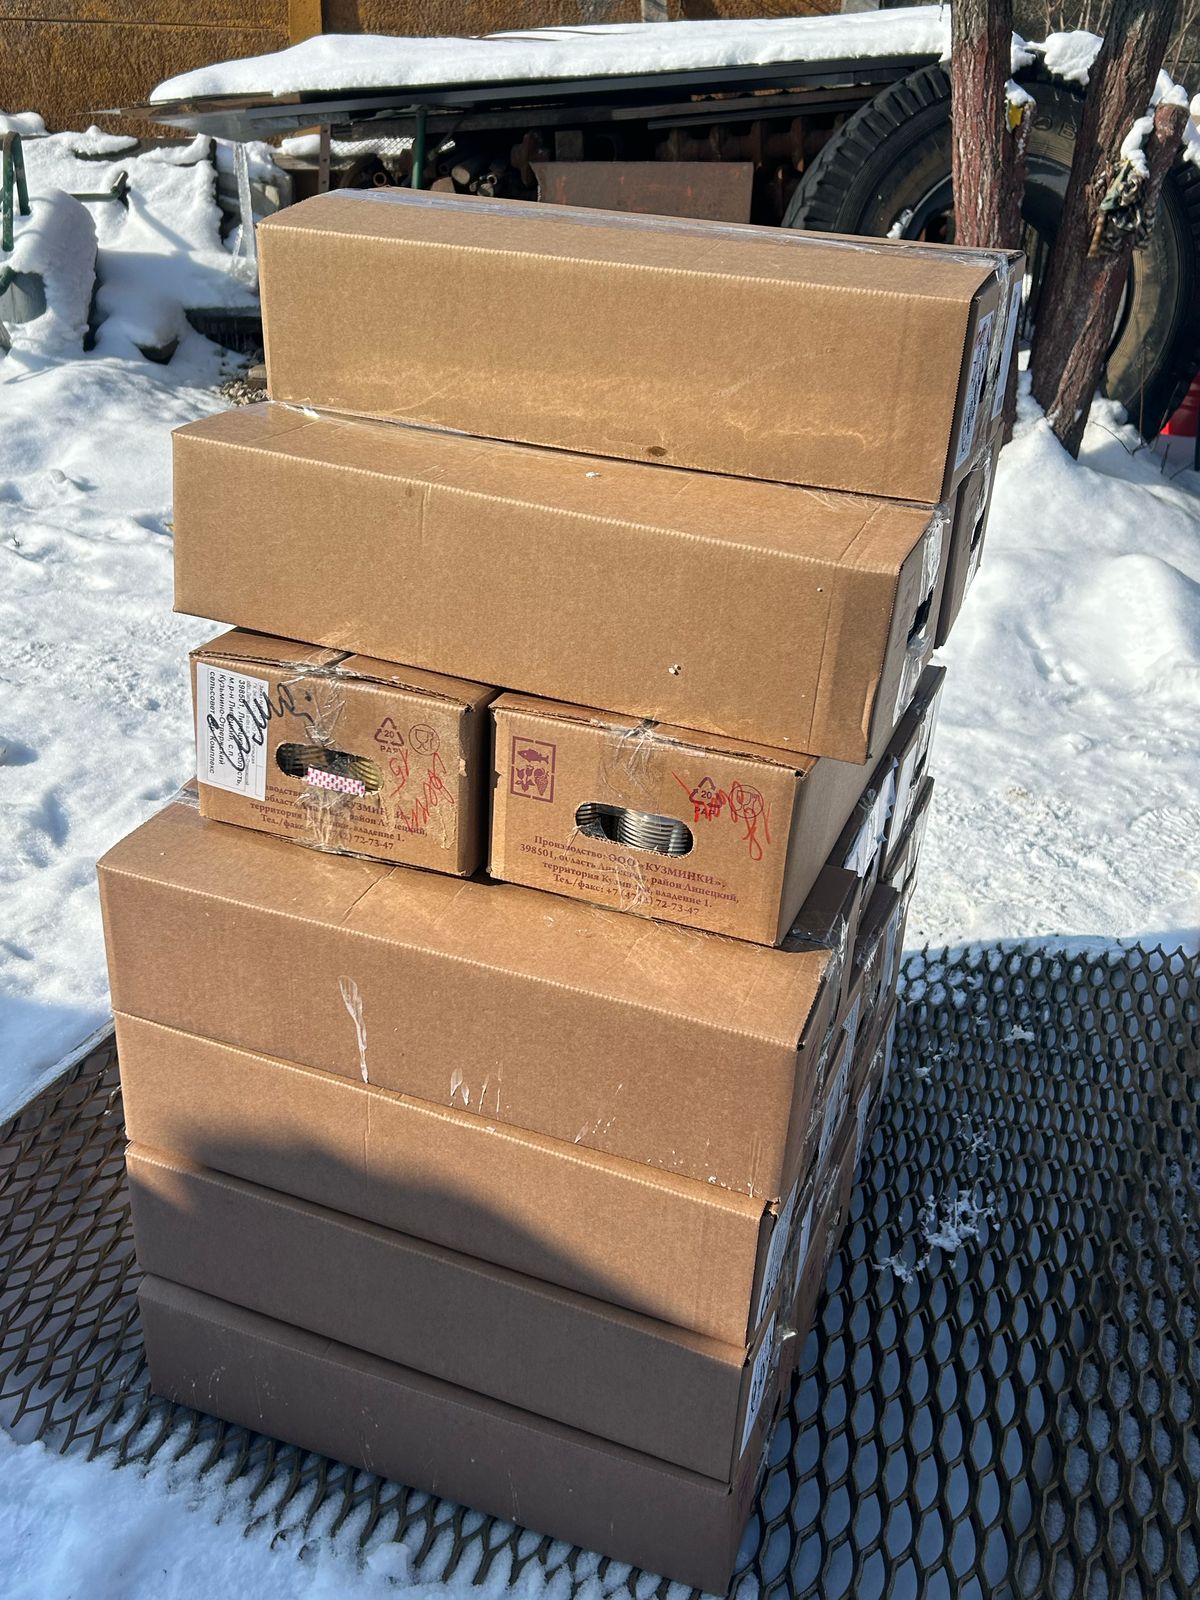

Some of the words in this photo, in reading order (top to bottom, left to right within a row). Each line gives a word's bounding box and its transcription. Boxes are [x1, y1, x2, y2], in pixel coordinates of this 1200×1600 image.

[238, 680, 246, 712] 398501,
[384, 729, 395, 739] 20
[208, 735, 217, 774] Комплекс
[701, 790, 713, 800] 20
[353, 835, 394, 850] 72-73-47
[520, 843, 557, 861] 398501,
[651, 877, 682, 891] район
[684, 884, 739, 904] Липецкий,
[543, 862, 600, 881] территория
[655, 898, 700, 915] 72-73-47
